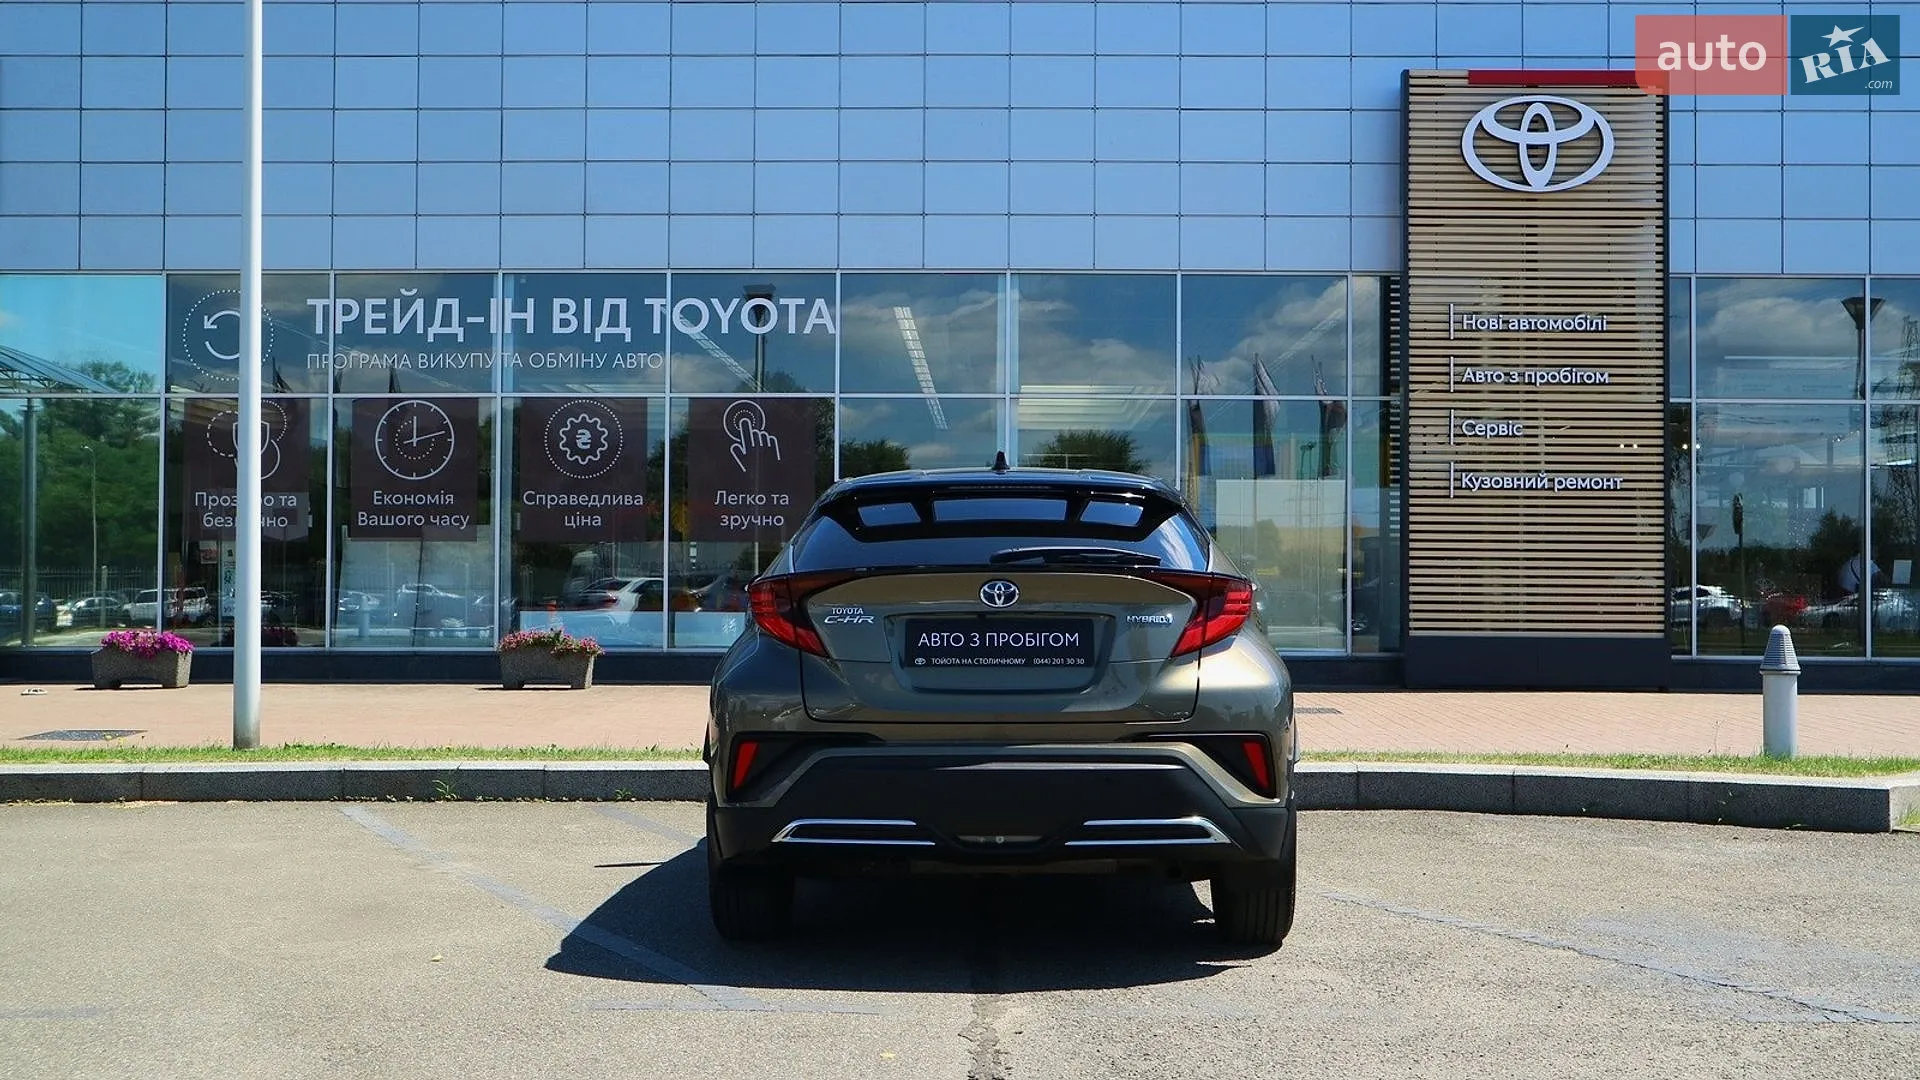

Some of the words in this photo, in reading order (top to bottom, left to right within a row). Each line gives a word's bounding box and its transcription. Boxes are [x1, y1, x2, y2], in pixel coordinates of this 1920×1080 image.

[307, 288, 534, 342] ТРЕЙД-ІН
[552, 298, 631, 342] ВІД
[644, 298, 836, 334] TOYOTA
[1462, 315, 1503, 331] Нові
[1508, 315, 1607, 332] автомобілі
[307, 353, 411, 369] ПРОГРАМА
[418, 353, 497, 369] ВИКУПУ
[499, 353, 523, 368] ТА
[529, 352, 606, 369] ОБМІНУ
[612, 353, 663, 369] АВТО
[1462, 368, 1504, 383] Авто
[1509, 371, 1518, 383] з
[1524, 367, 1609, 386] пробігом
[1461, 420, 1523, 438] Сервіс
[1461, 473, 1548, 492] Кузовний
[1554, 477, 1623, 492] ремонт
[195, 492, 274, 509] Прозо
[279, 495, 297, 506] та
[373, 491, 454, 505] Економія
[523, 491, 644, 509] Справедлива
[714, 491, 766, 505] Легко
[771, 495, 789, 506] та
[358, 512, 424, 526] Вашого
[430, 516, 469, 529] часу
[564, 512, 602, 528] ціна
[720, 516, 784, 530] зручно
[832, 607, 864, 615] TOYOTA
[1126, 615, 1166, 623] HYBRID
[824, 615, 874, 624] C-HR
[918, 633, 964, 647] АВТО
[986, 633, 1079, 647] ПРОБІГОМ
[931, 657, 960, 665] ТОЙОТА
[973, 657, 1026, 665] СТОЛИЧНОМУ
